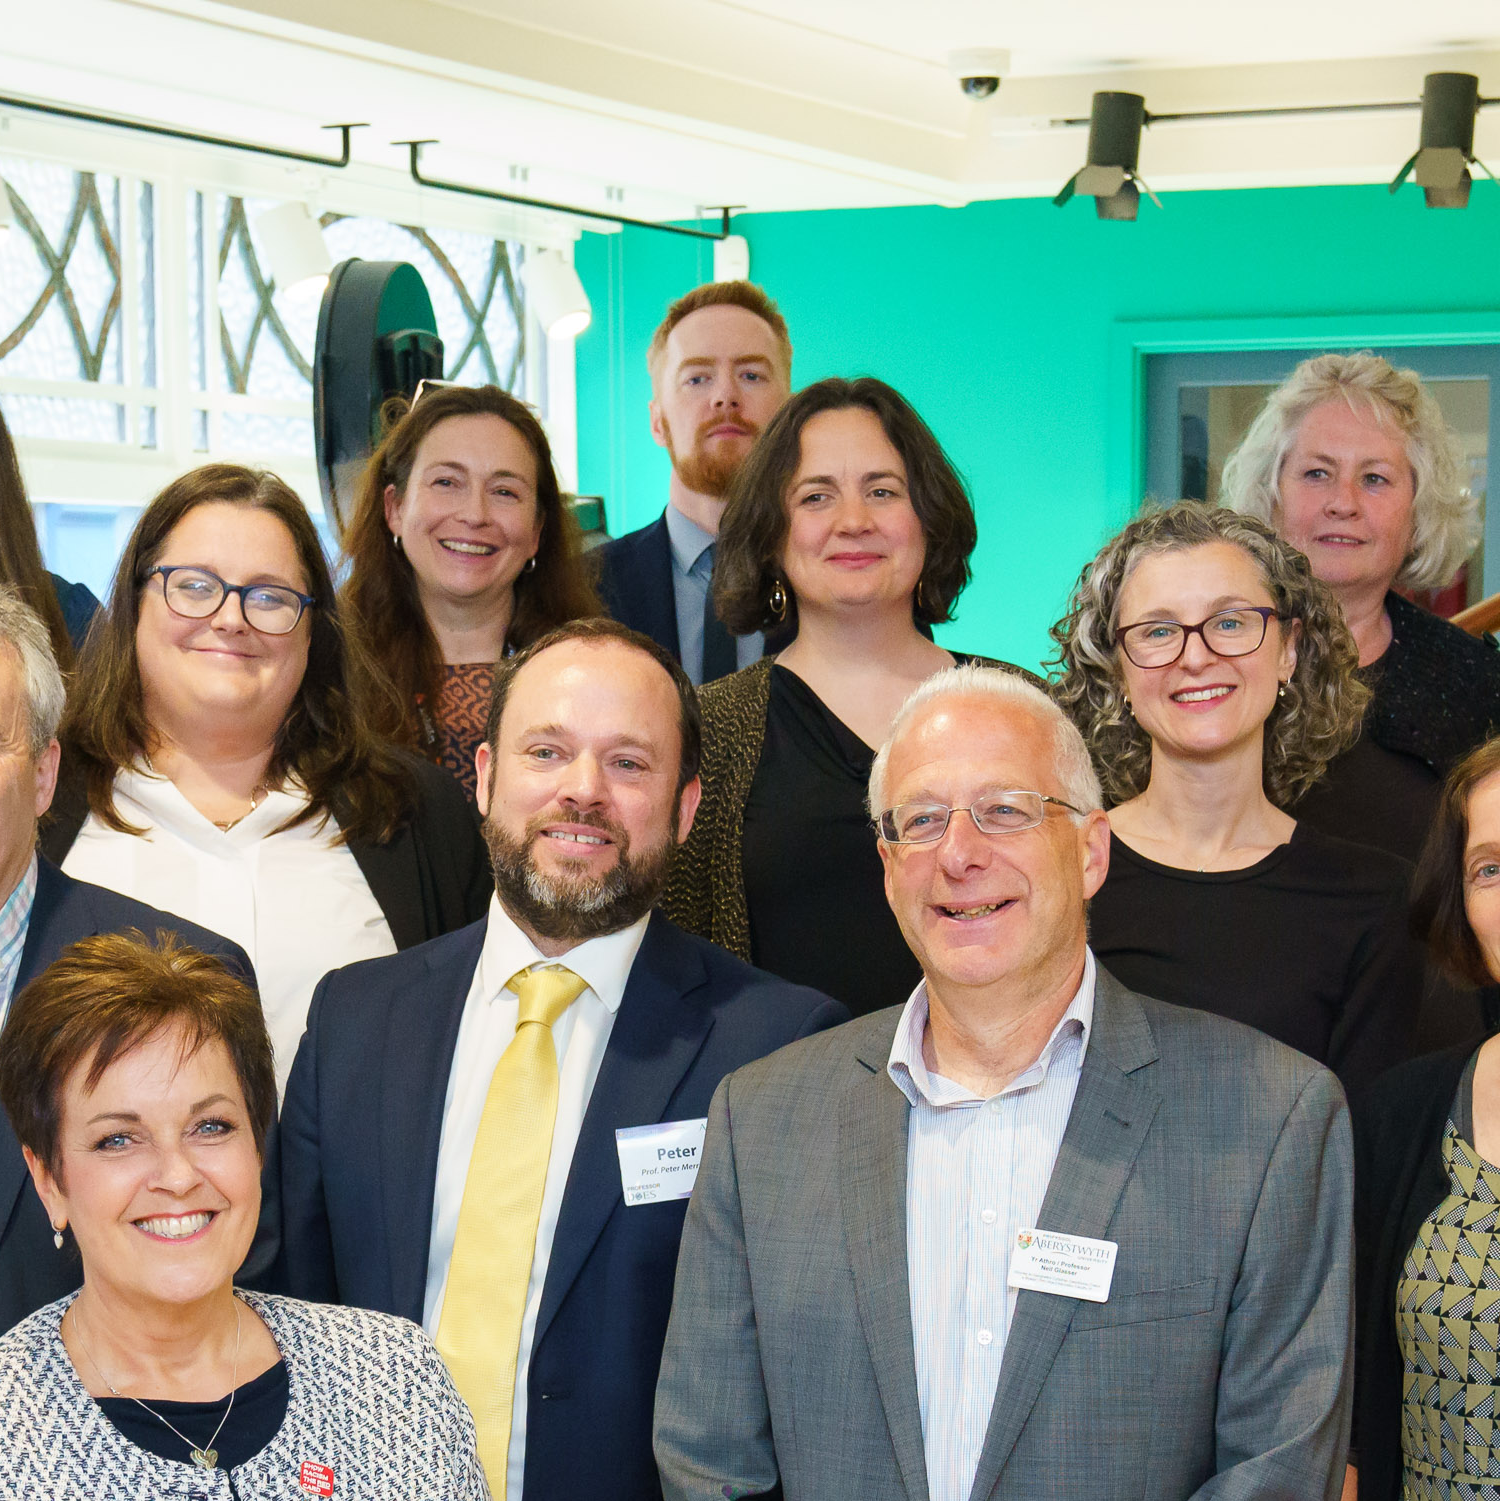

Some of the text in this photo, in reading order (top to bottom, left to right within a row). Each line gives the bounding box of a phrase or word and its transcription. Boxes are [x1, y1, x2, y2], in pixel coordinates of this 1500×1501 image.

[657, 1146, 697, 1161] Peter
[641, 1167, 660, 1176] Prof.
[660, 1165, 680, 1174] Peter
[1032, 1236, 1110, 1259] ABERYSTWYTH
[1038, 1257, 1056, 1266] Athro
[1060, 1261, 1091, 1271] Professor
[303, 1462, 324, 1472] SHOW
[303, 1476, 316, 1485] THE
[303, 1483, 321, 1492] CARD
